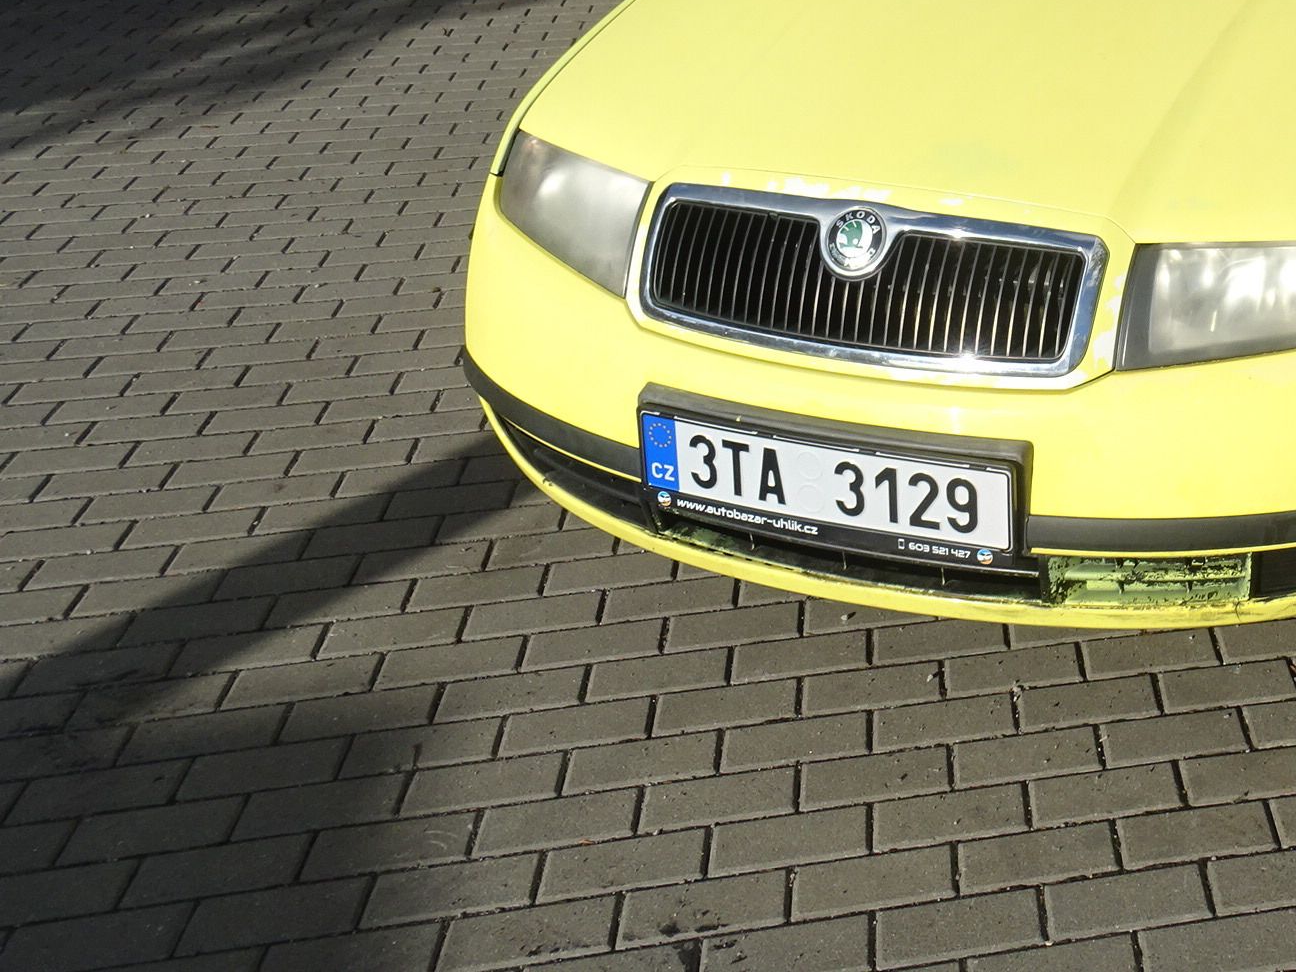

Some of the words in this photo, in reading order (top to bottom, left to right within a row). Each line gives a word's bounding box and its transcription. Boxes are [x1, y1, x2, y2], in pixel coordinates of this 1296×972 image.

[651, 462, 675, 481] CZ
[689, 434, 786, 505] 3TA
[834, 461, 978, 535] 3129
[676, 498, 819, 535] www.autobazar-uhlik.cz
[908, 542, 930, 552] 603
[932, 546, 949, 555] 521
[951, 548, 971, 559] 427
